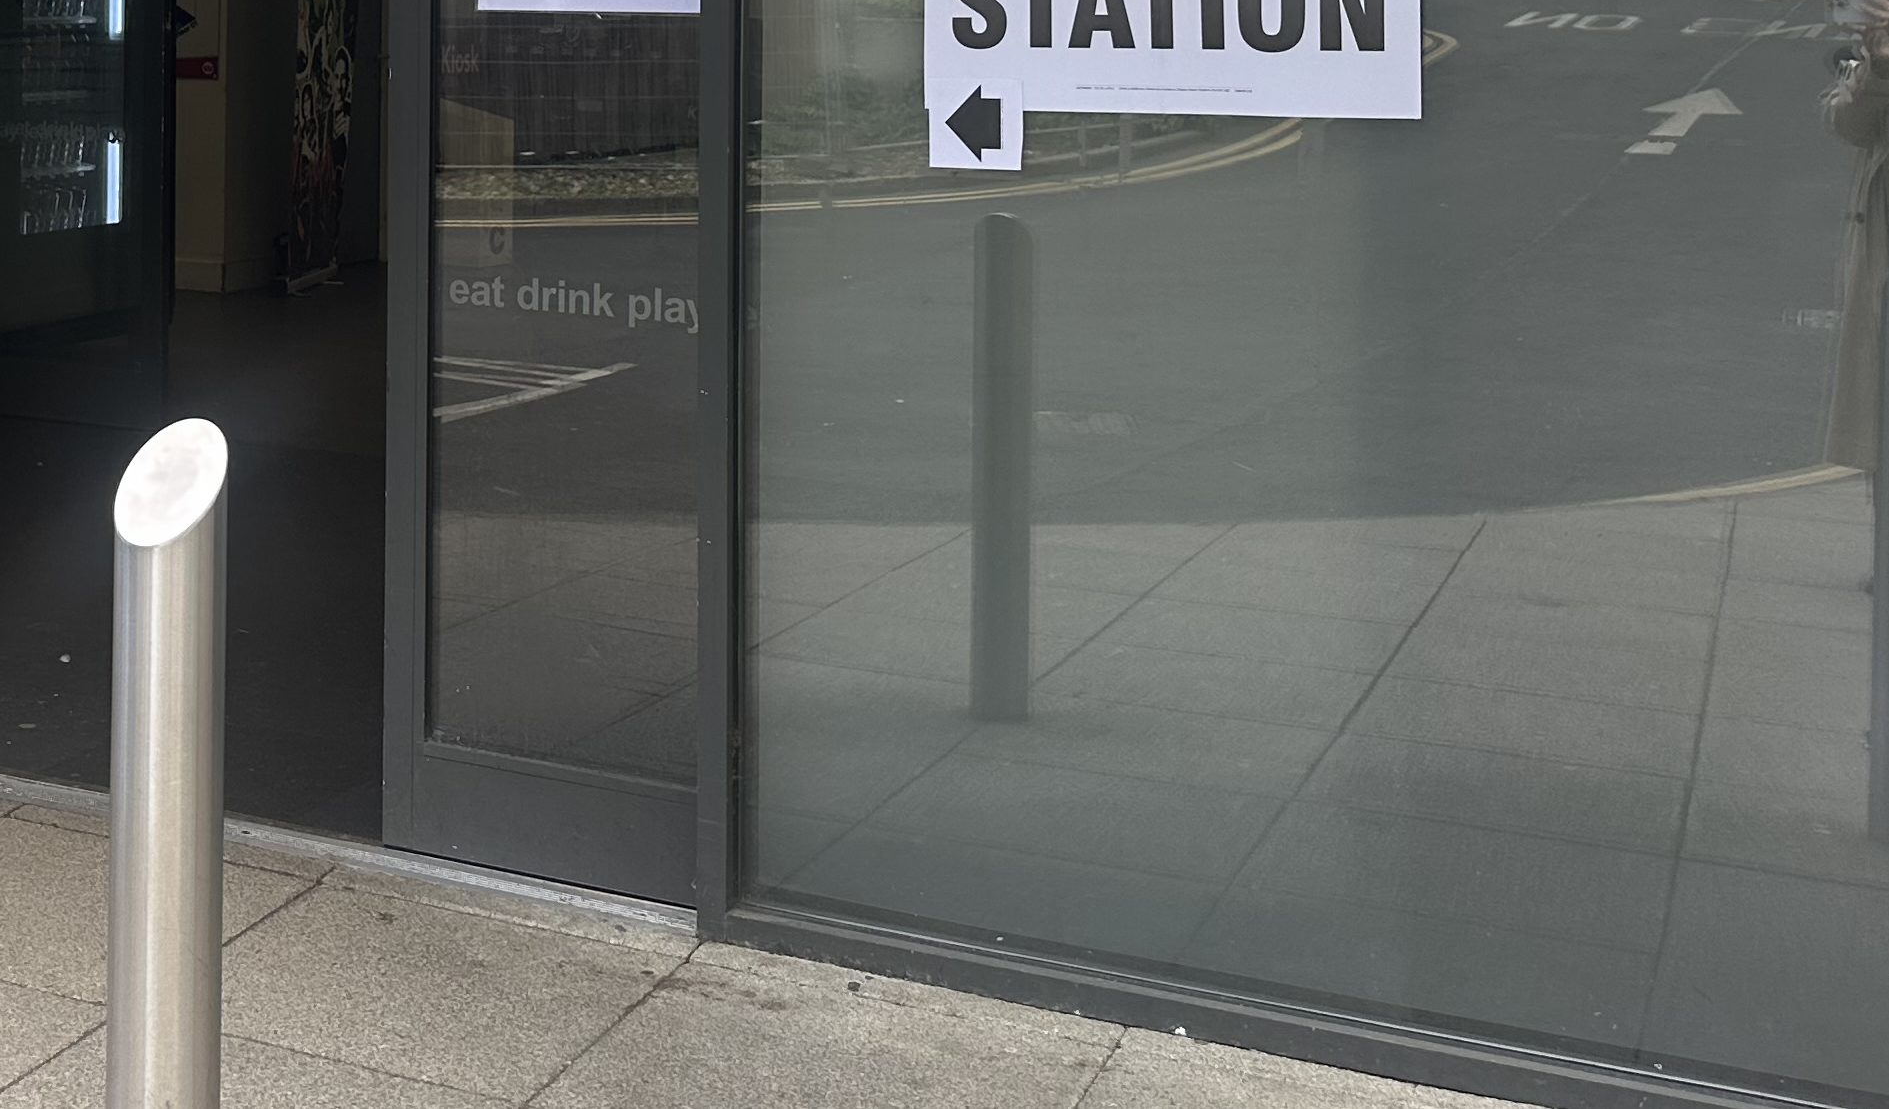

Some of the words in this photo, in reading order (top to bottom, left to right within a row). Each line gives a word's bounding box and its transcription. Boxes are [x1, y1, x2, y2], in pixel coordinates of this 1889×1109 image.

[441, 43, 480, 73] Kiosk
[449, 275, 505, 309] eat
[517, 277, 615, 318] drink
[628, 287, 699, 334] play
